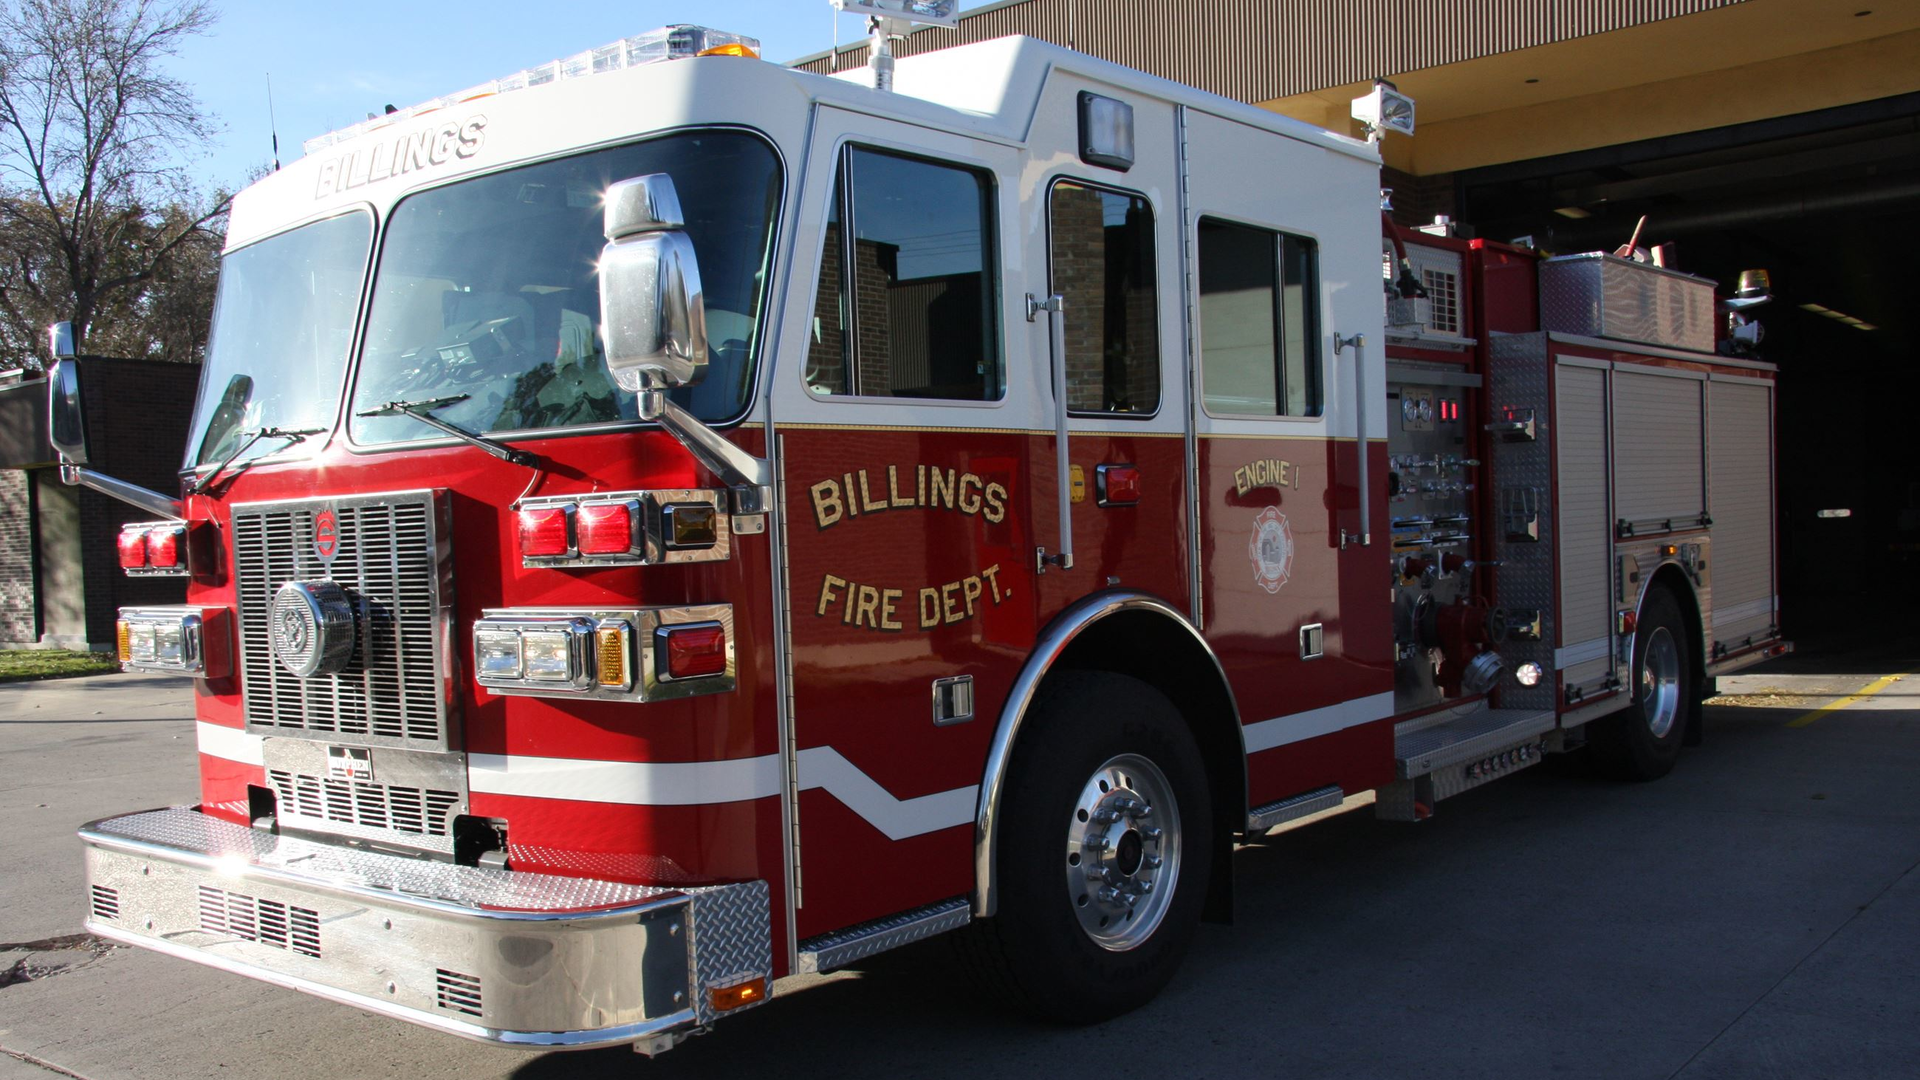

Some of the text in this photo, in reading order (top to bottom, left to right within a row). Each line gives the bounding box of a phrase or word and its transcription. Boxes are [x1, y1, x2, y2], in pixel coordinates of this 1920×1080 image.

[314, 113, 489, 200] BILLINGS
[809, 465, 1007, 530] BILLINGS
[1234, 459, 1290, 497] ENGINE
[817, 564, 1011, 631] FIRE DEPT.
